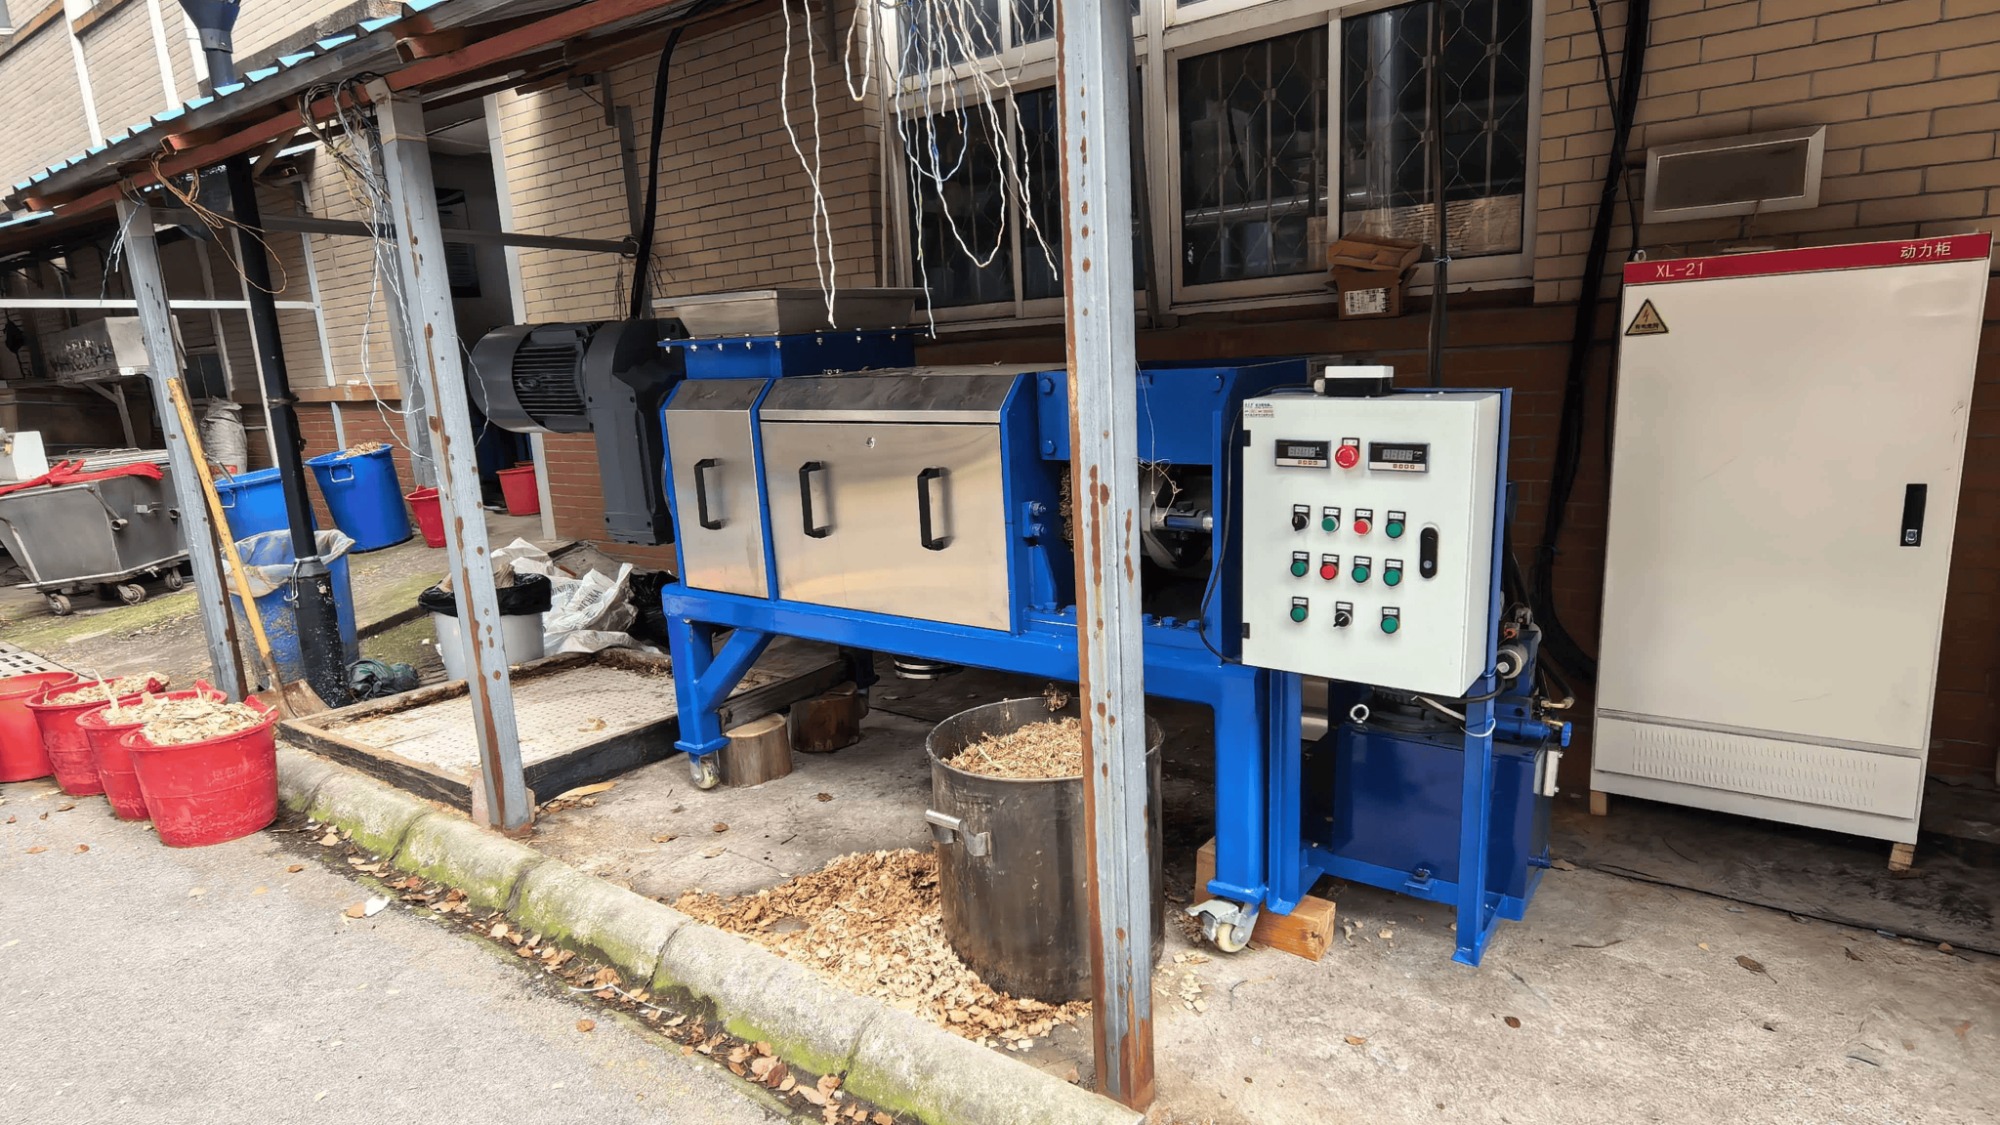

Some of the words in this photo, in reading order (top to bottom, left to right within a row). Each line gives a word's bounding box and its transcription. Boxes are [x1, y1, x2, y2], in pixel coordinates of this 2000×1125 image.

[1900, 241, 1952, 259] 动力柜
[1655, 261, 1704, 278] XL-21
